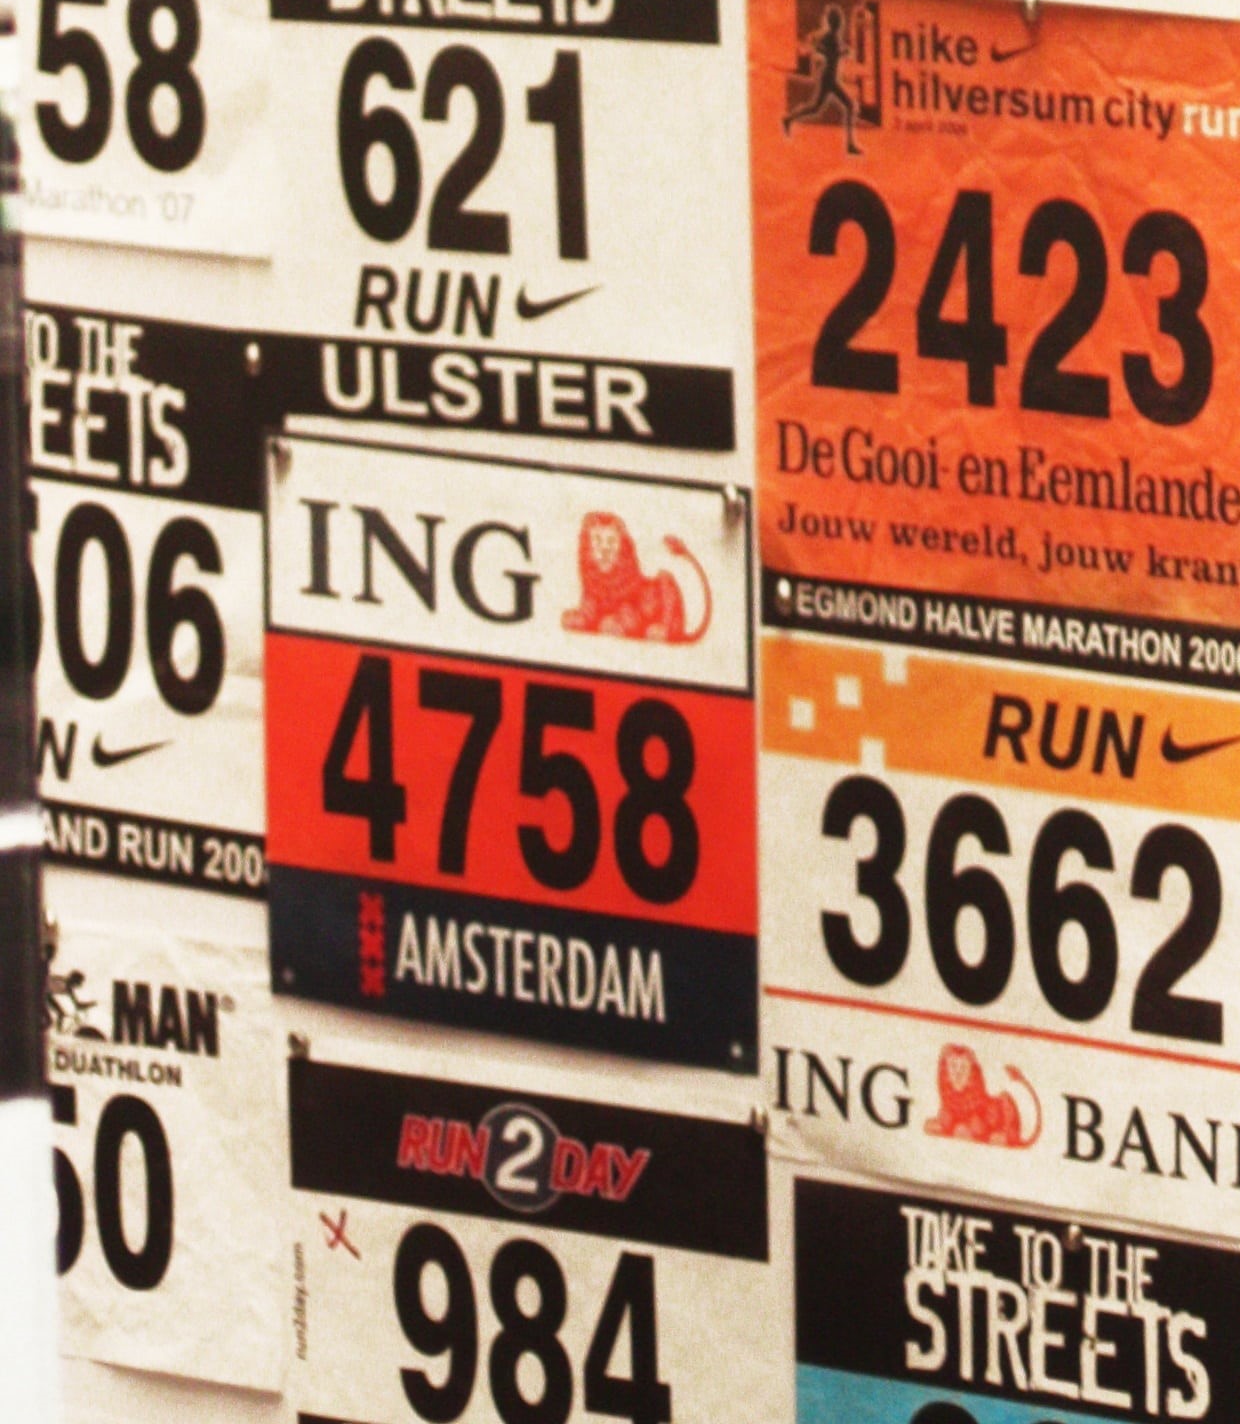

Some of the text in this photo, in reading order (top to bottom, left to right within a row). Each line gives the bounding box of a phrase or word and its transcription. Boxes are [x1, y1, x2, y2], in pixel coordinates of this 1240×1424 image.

[891, 26, 978, 67] nike
[337, 35, 589, 263] 621
[891, 71, 1096, 127] hilversum
[1104, 87, 1174, 140] city
[354, 265, 503, 339] RUN
[808, 179, 1215, 428] 2423
[321, 343, 655, 437] ULSTER
[299, 497, 541, 624] ING
[794, 581, 918, 629] EGMOND
[924, 594, 1014, 645] HALVE
[1022, 608, 1183, 669] MARATHON
[322, 654, 700, 908] 4758
[982, 692, 1147, 780] RUN
[820, 773, 1225, 1047] 3662
[396, 912, 666, 1023] AMSTERDAM
[772, 1045, 913, 1130] ING
[393, 1221, 672, 1424] 984
[904, 1269, 1211, 1420] STREETS
